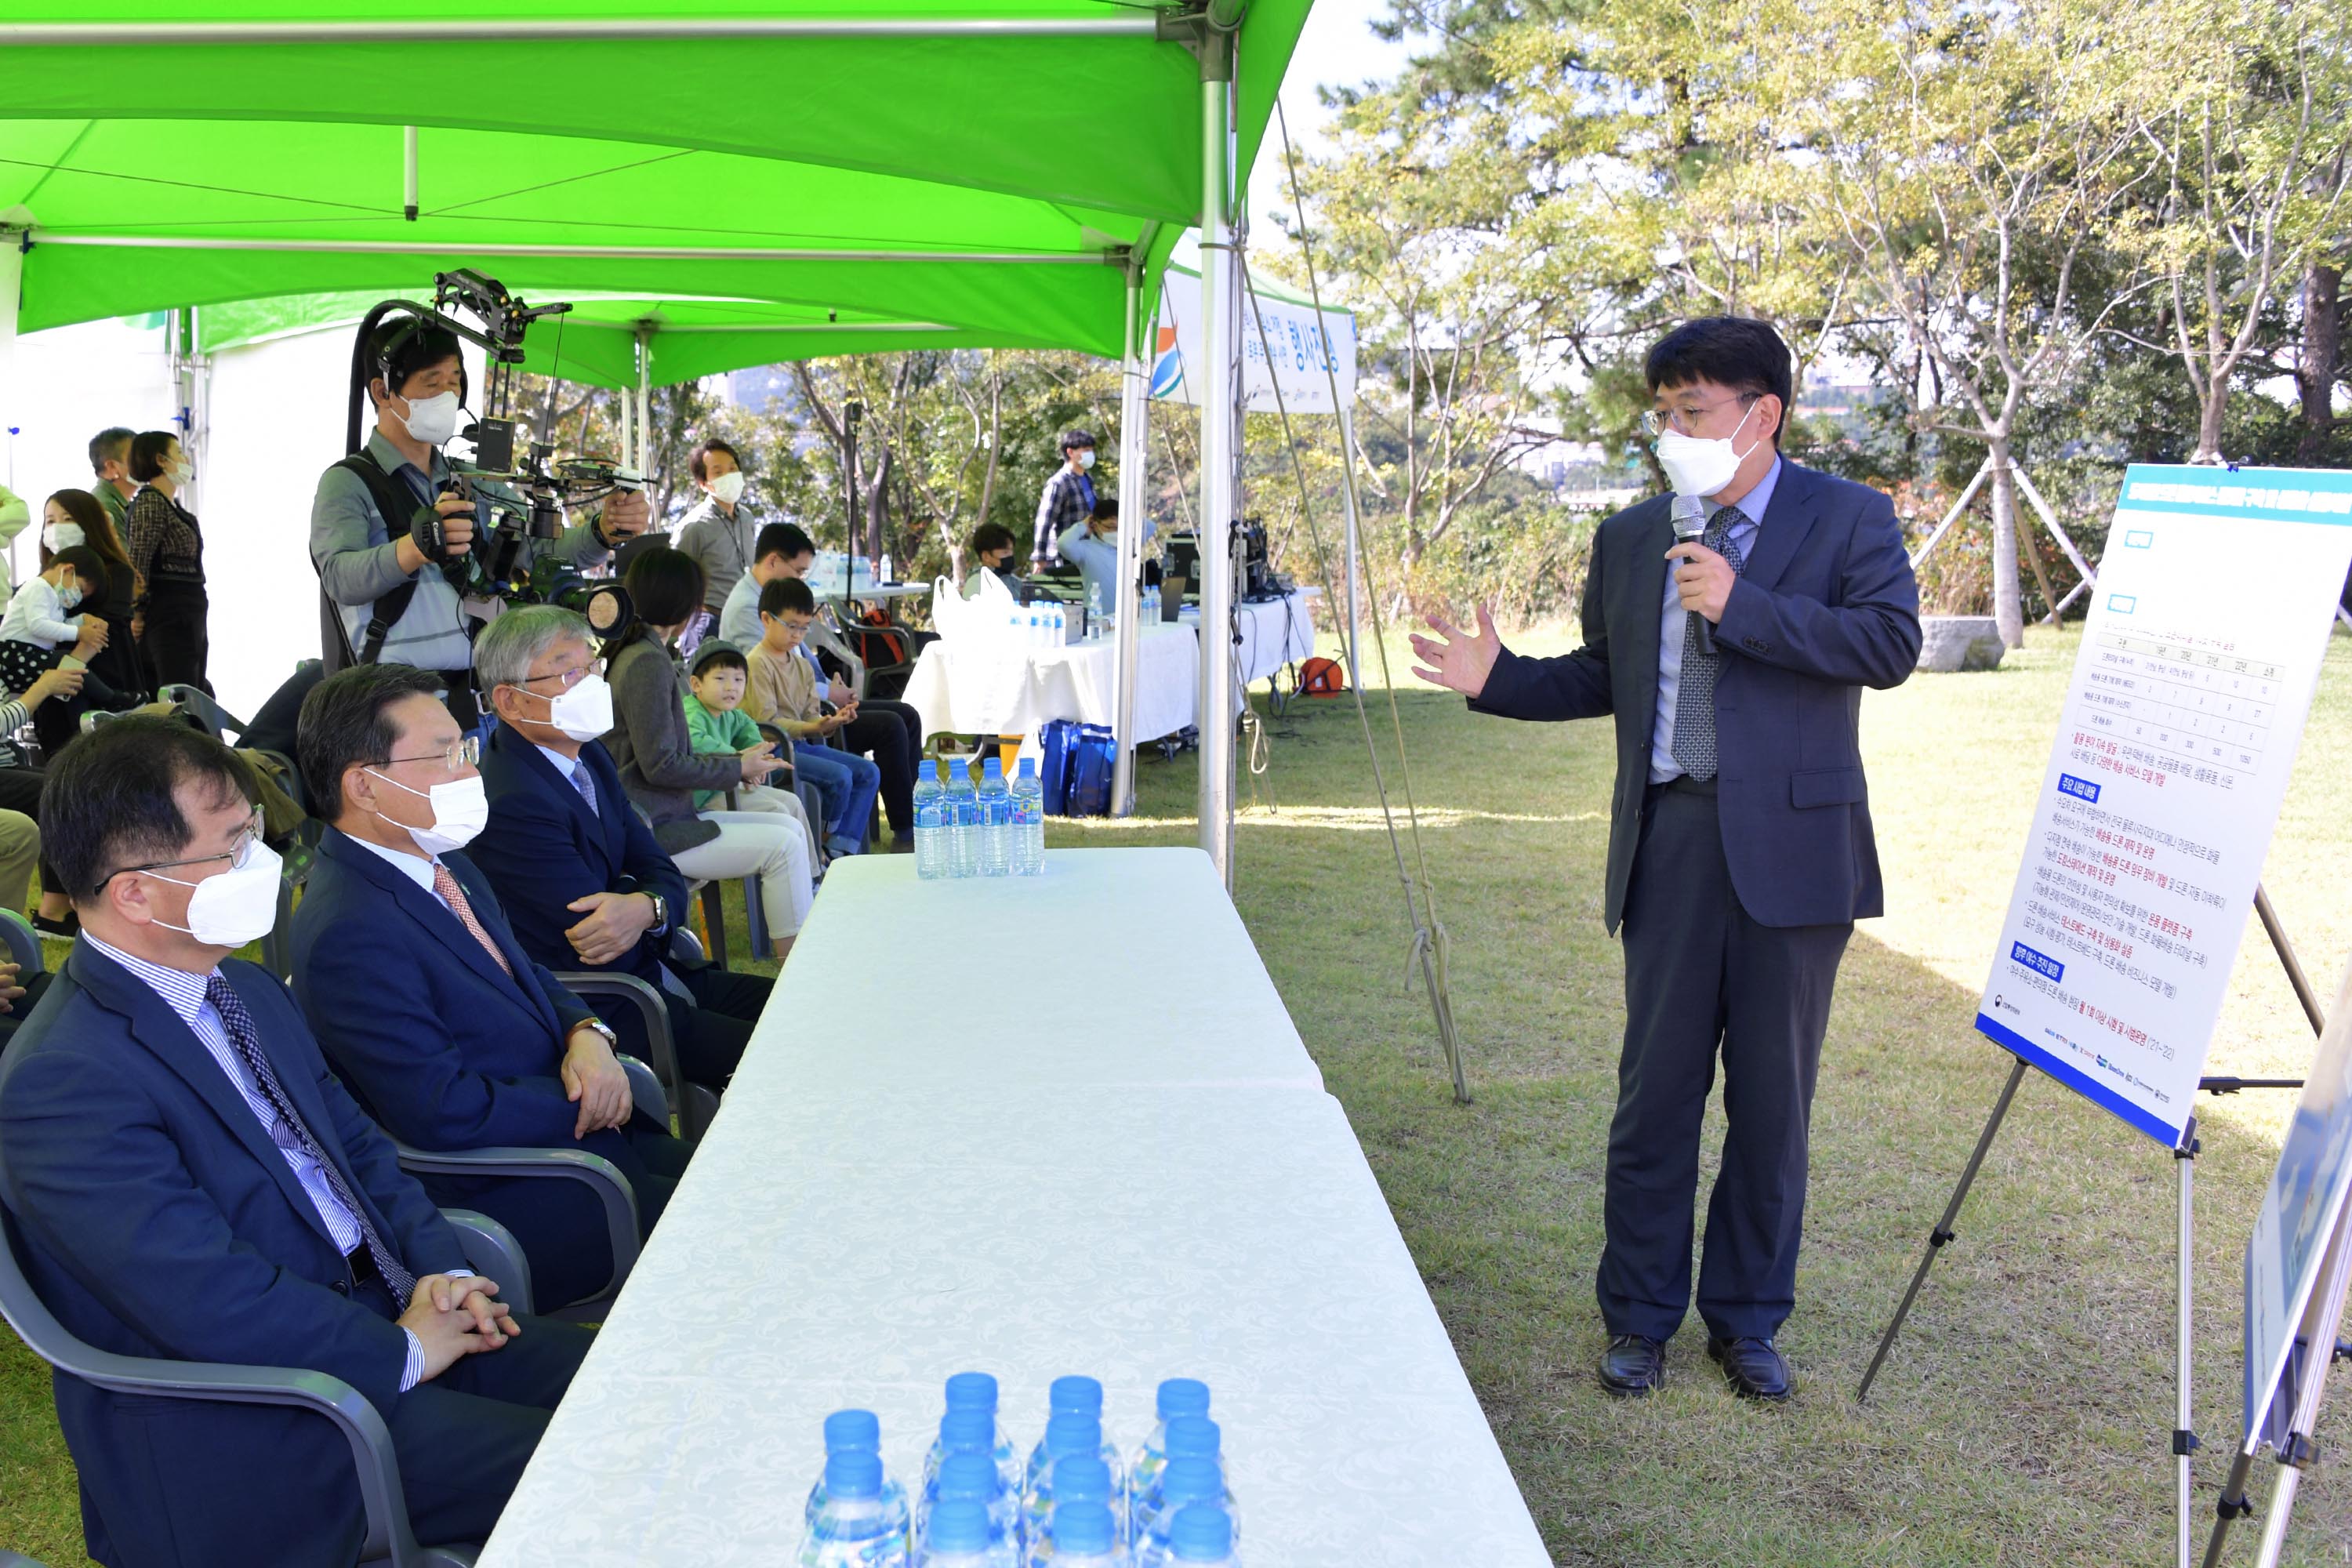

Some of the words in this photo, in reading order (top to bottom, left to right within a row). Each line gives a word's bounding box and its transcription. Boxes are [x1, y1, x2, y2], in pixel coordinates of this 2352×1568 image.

[2096, 755, 2113, 771] 다양한
[2112, 760, 2124, 774] 배송
[2124, 764, 2141, 779] 서비스
[2061, 777, 2074, 791] 주요
[2073, 781, 2085, 795] 사업
[2083, 784, 2096, 799] 내용
[2095, 828, 2112, 844] 배송용
[2111, 834, 2124, 849] 드론
[2142, 845, 2155, 860] 운영
[2101, 852, 2119, 869] 배송용
[2118, 858, 2131, 874] 드론
[2175, 880, 2188, 897] 드론
[2103, 870, 2116, 887] 운영
[2027, 900, 2038, 914] 드론
[2060, 915, 2087, 937] 테스트베드
[2085, 927, 2098, 942] 구축
[2137, 927, 2151, 944] 드론
[2180, 925, 2194, 942] 구축
[2025, 951, 2038, 967] 여수
[2036, 956, 2048, 972] 추진
[2046, 961, 2060, 978] 일정
[2103, 953, 2116, 970] 드론
[2046, 984, 2058, 1000] 드론
[2078, 1000, 2085, 1014] 월
[2094, 1009, 2107, 1026] 이상
[2123, 1024, 2147, 1047] 시범운영
